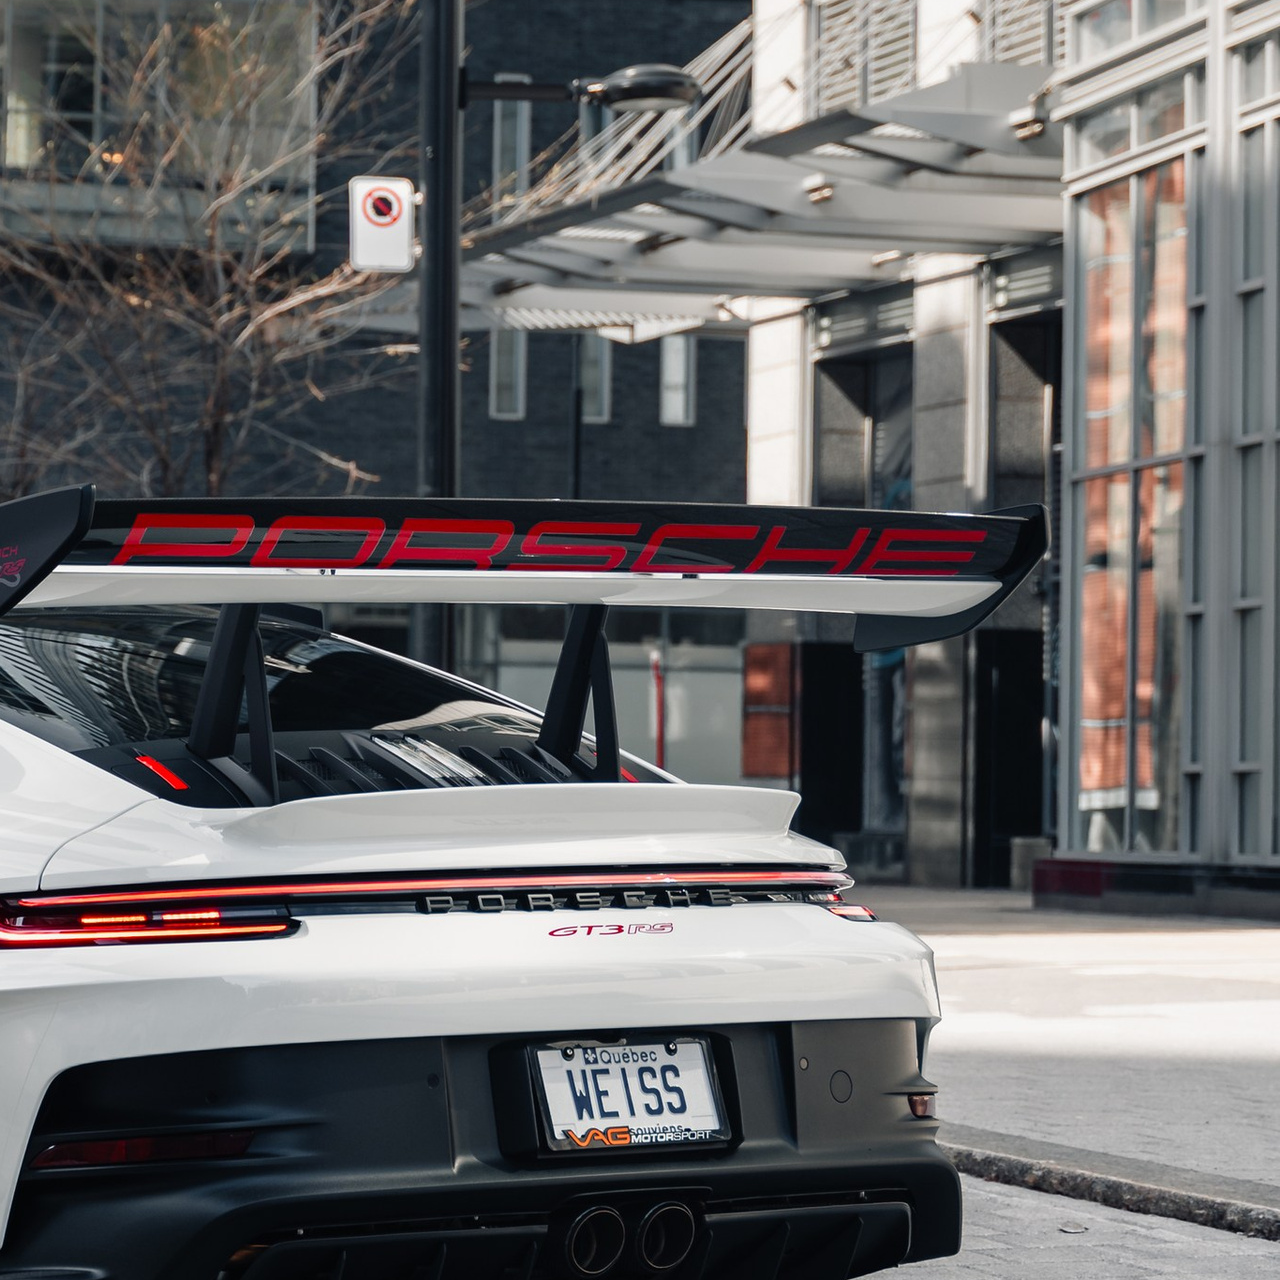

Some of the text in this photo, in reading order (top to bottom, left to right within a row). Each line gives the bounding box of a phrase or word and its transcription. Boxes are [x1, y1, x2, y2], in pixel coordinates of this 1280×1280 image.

[107, 513, 989, 576] PORSCHE
[424, 888, 732, 913] PORSCHE
[599, 1048, 658, 1064] Québec
[566, 1064, 687, 1121] WEISS
[565, 1125, 712, 1147] VAG MOTORSPORT
